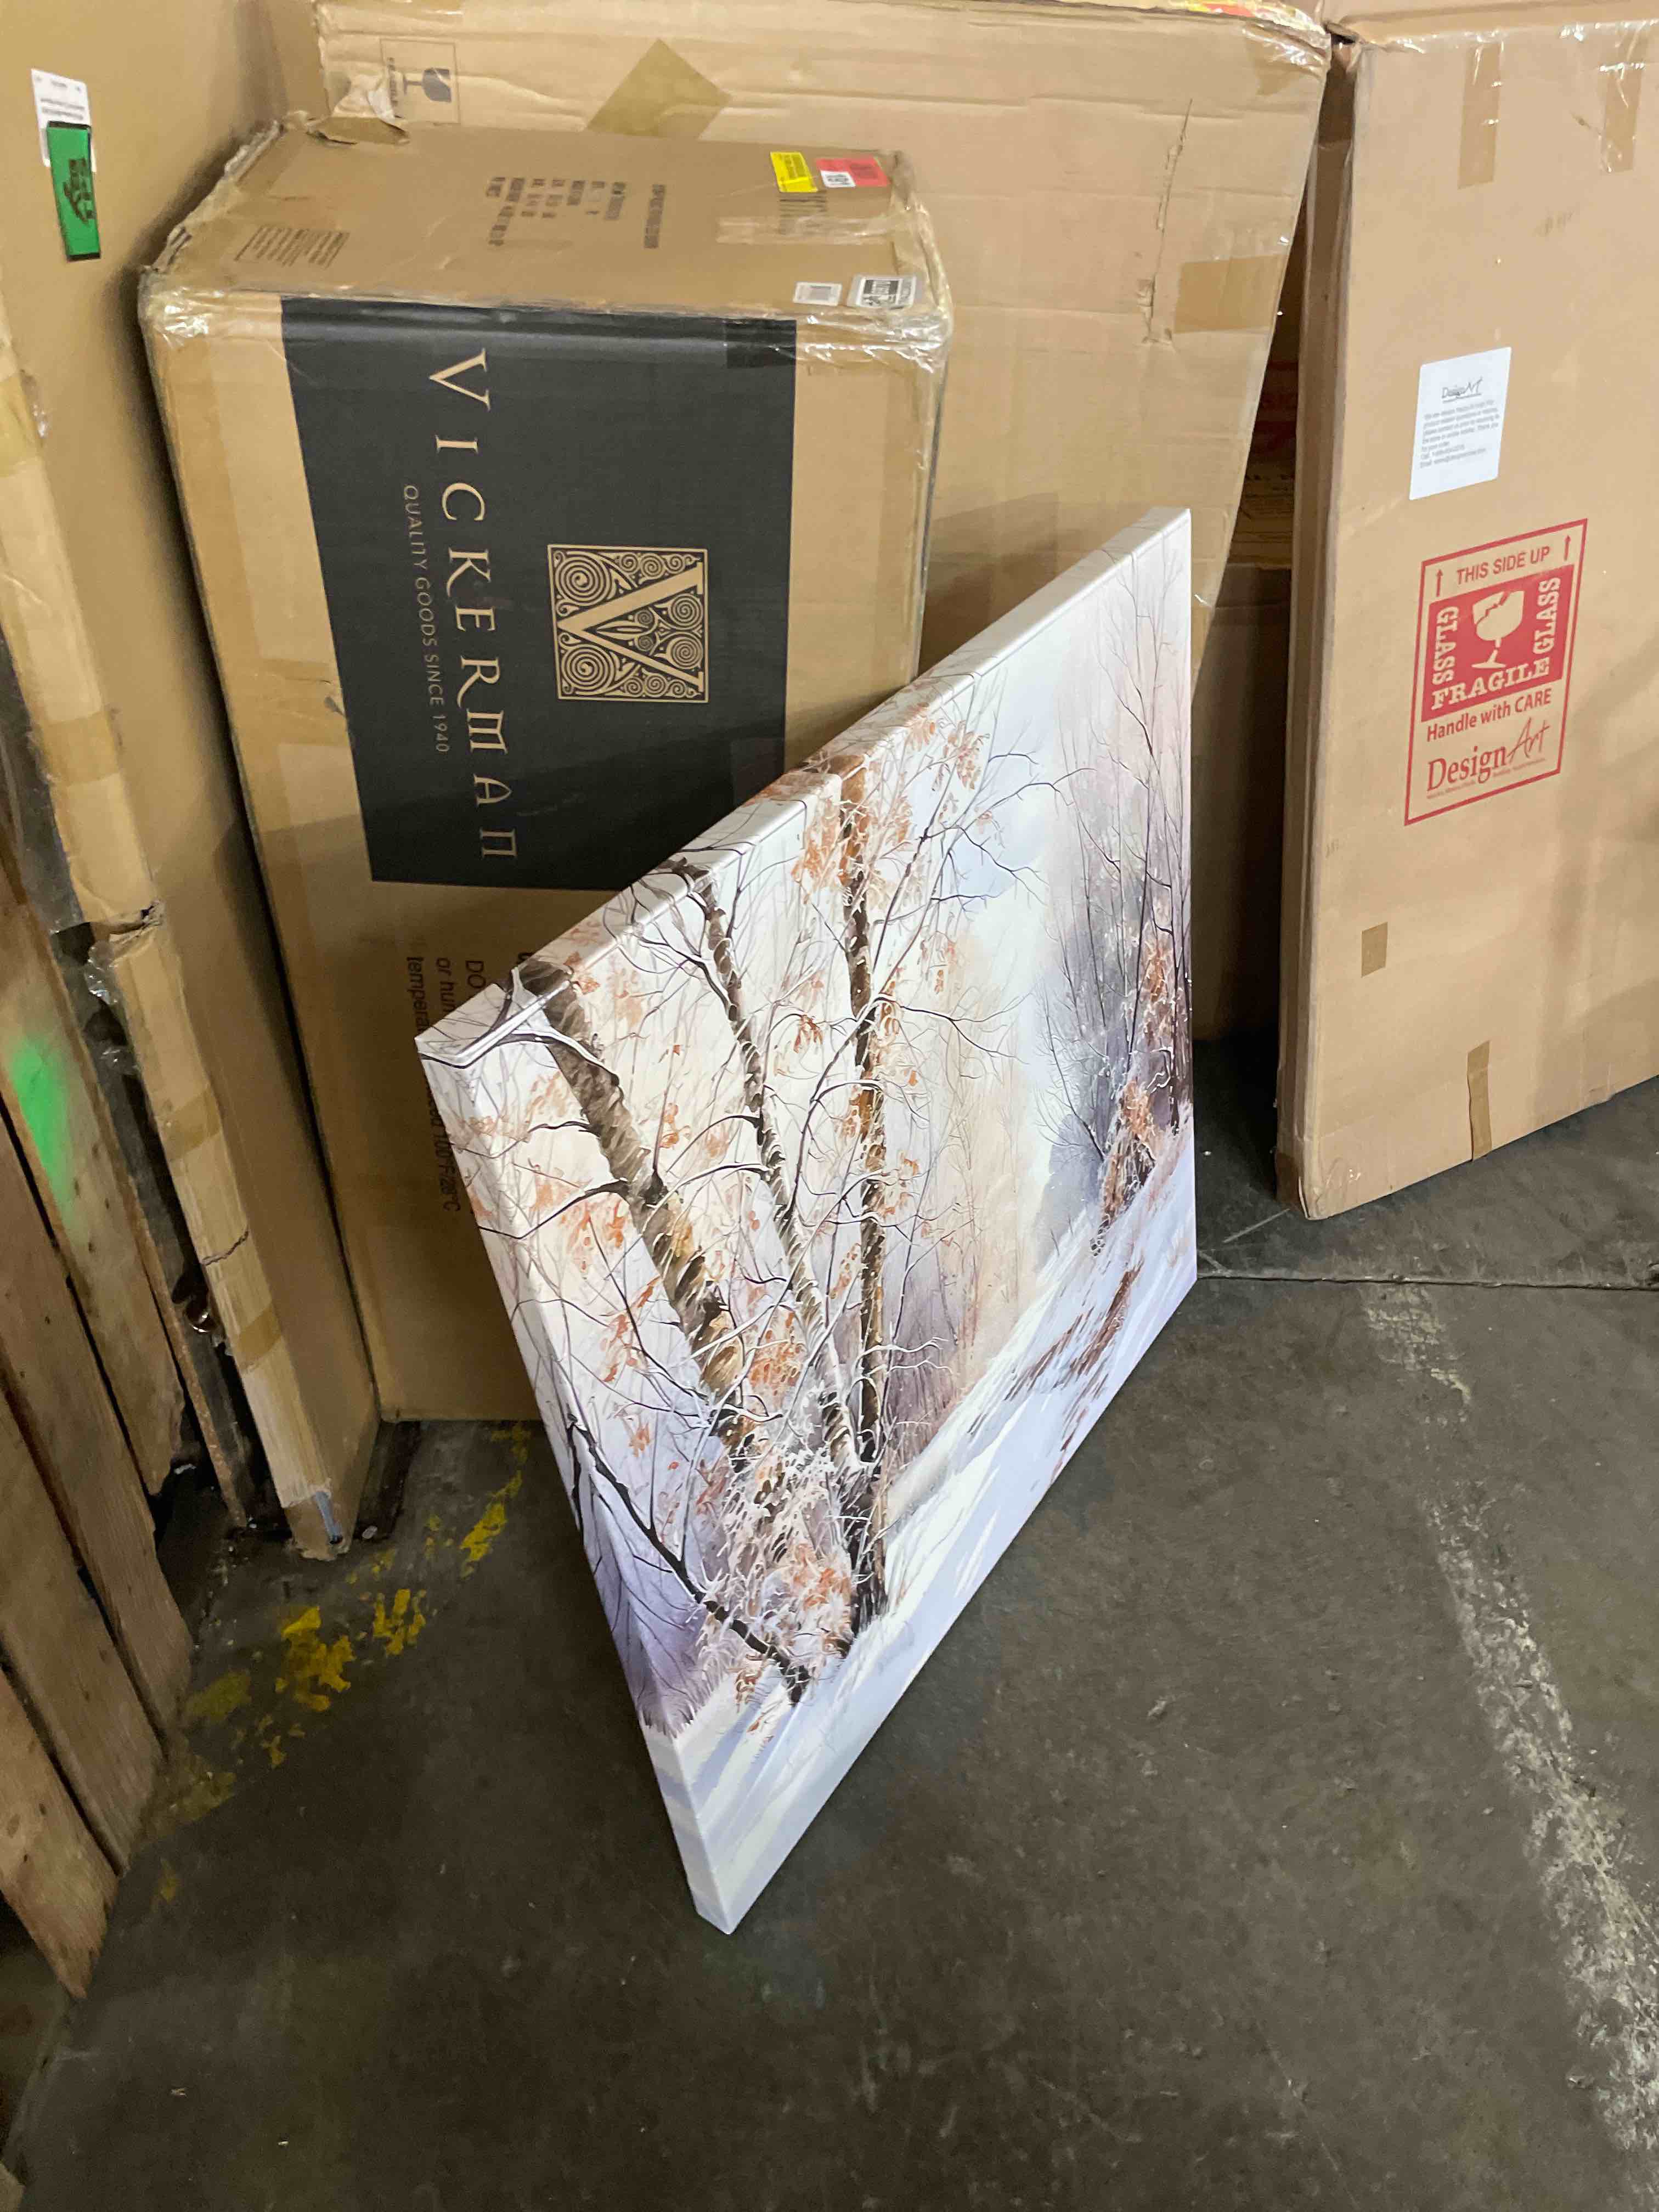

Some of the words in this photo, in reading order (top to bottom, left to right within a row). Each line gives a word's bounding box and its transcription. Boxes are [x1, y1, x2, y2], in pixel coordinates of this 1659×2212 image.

[403, 485, 428, 570] QUALITY
[1456, 562, 1488, 585] THIS
[1493, 552, 1526, 574] SIDE
[1530, 546, 1550, 564] UP
[415, 577, 438, 646] GOODS
[428, 347, 517, 859] VICKERMAN
[1533, 578, 1561, 654] GLASS
[1432, 606, 1459, 685] GLASS
[424, 654, 444, 706] SINCE
[1431, 657, 1550, 710] FRAGILE
[433, 714, 450, 752] 1940
[1427, 713, 1477, 742] Handle
[1481, 701, 1510, 723] with
[1515, 687, 1552, 713] CARE
[436, 957, 452, 977] or
[465, 960, 486, 989] DO
